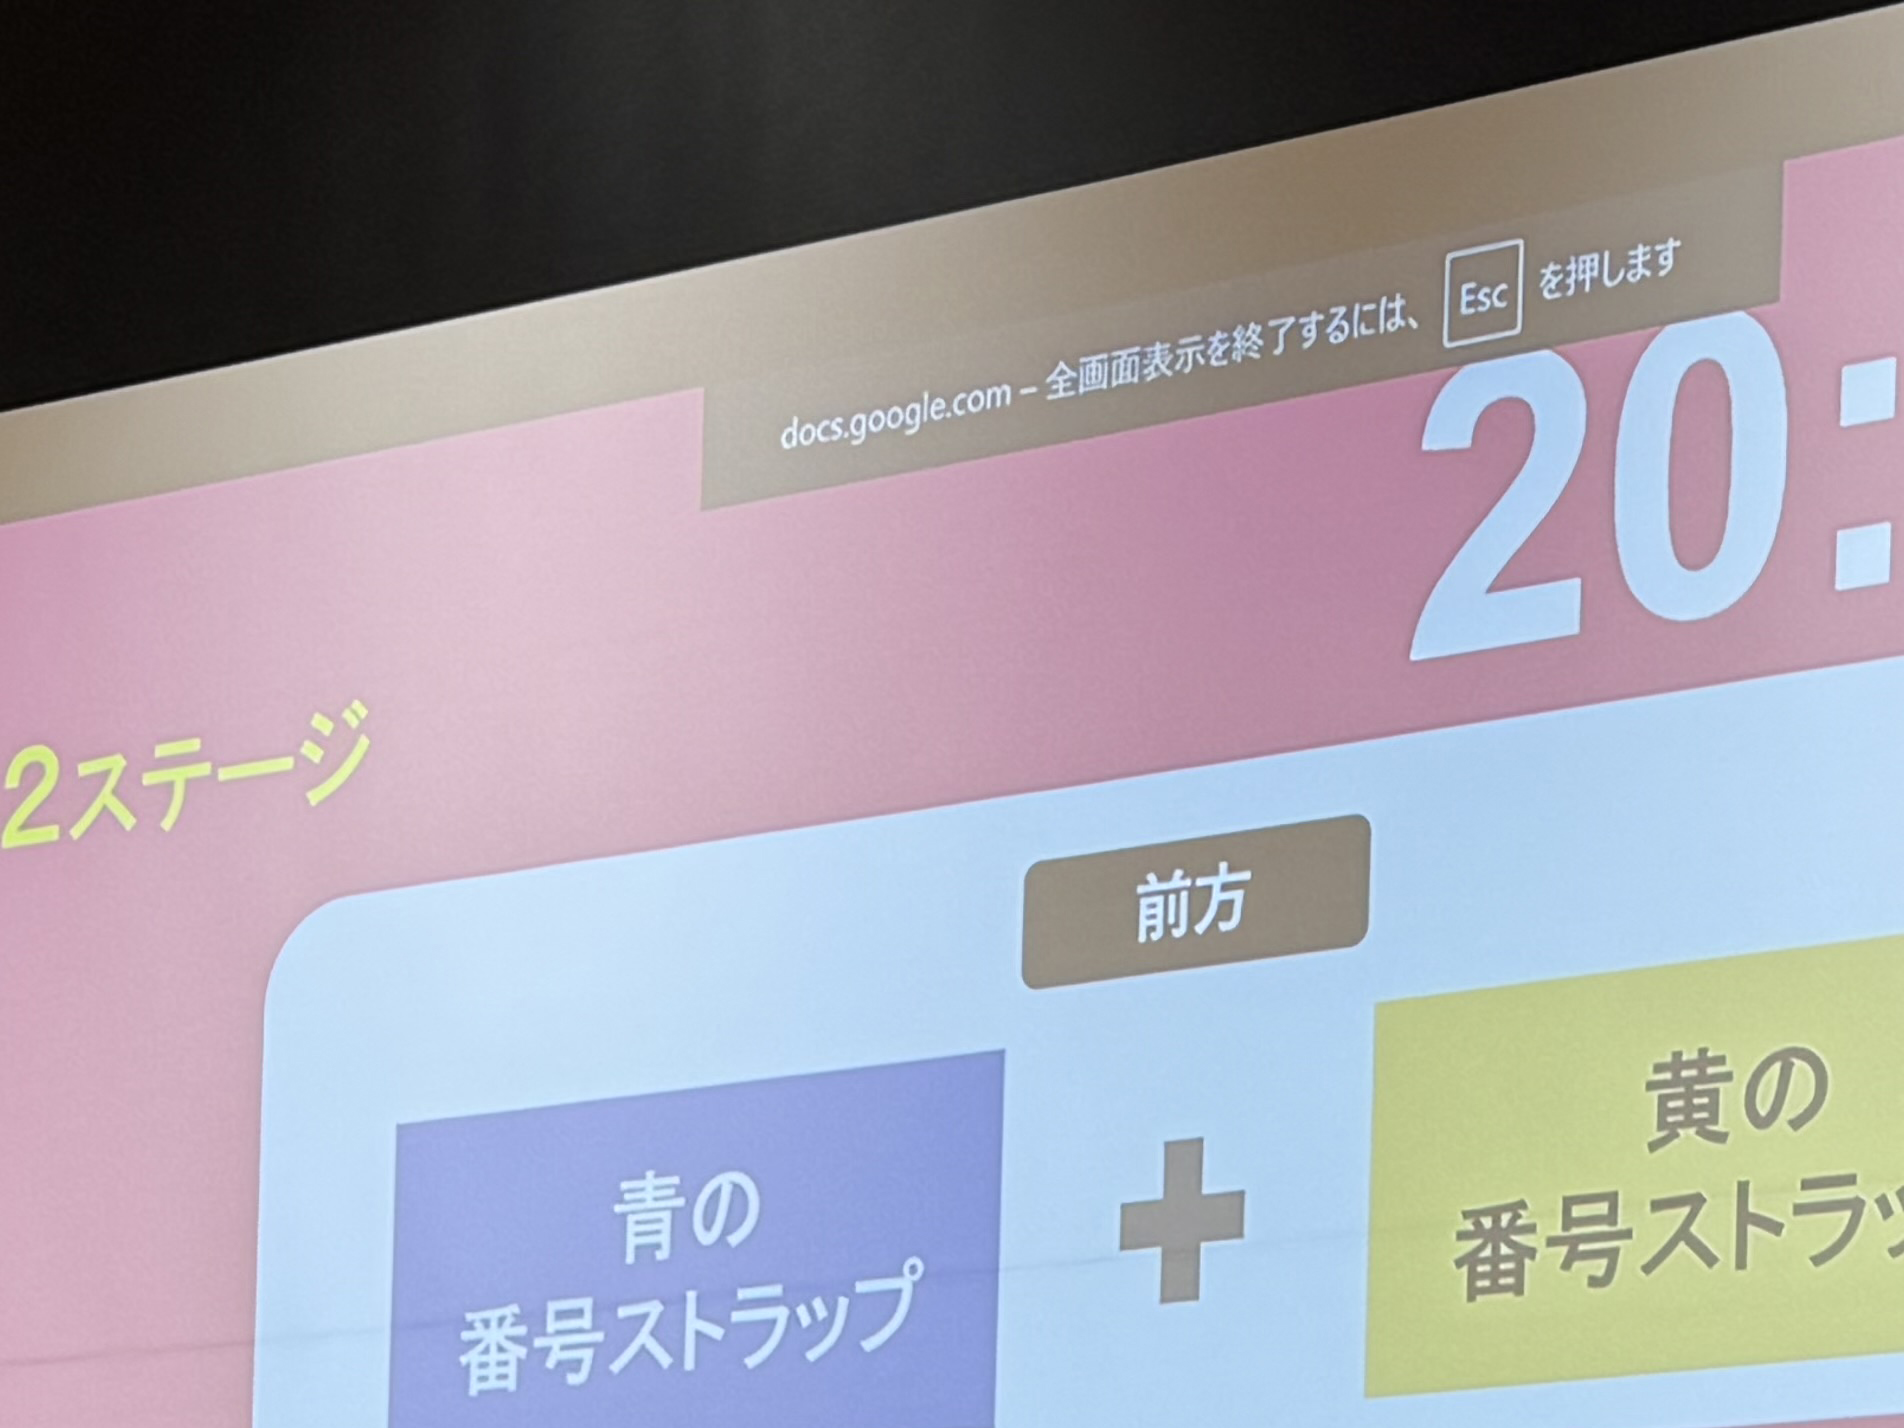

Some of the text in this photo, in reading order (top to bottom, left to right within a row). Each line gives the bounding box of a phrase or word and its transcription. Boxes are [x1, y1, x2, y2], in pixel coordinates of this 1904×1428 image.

[780, 381, 1012, 450] docs.google.com
[1045, 292, 1419, 402] 全画面表示を終了するには、
[1459, 282, 1509, 316] Esc
[1539, 236, 1682, 301] を押します
[1136, 860, 1251, 944] 前方
[1645, 1045, 1830, 1154] 黄の
[613, 1168, 760, 1266] 青の
[458, 1255, 925, 1397] 番号ストラップ
